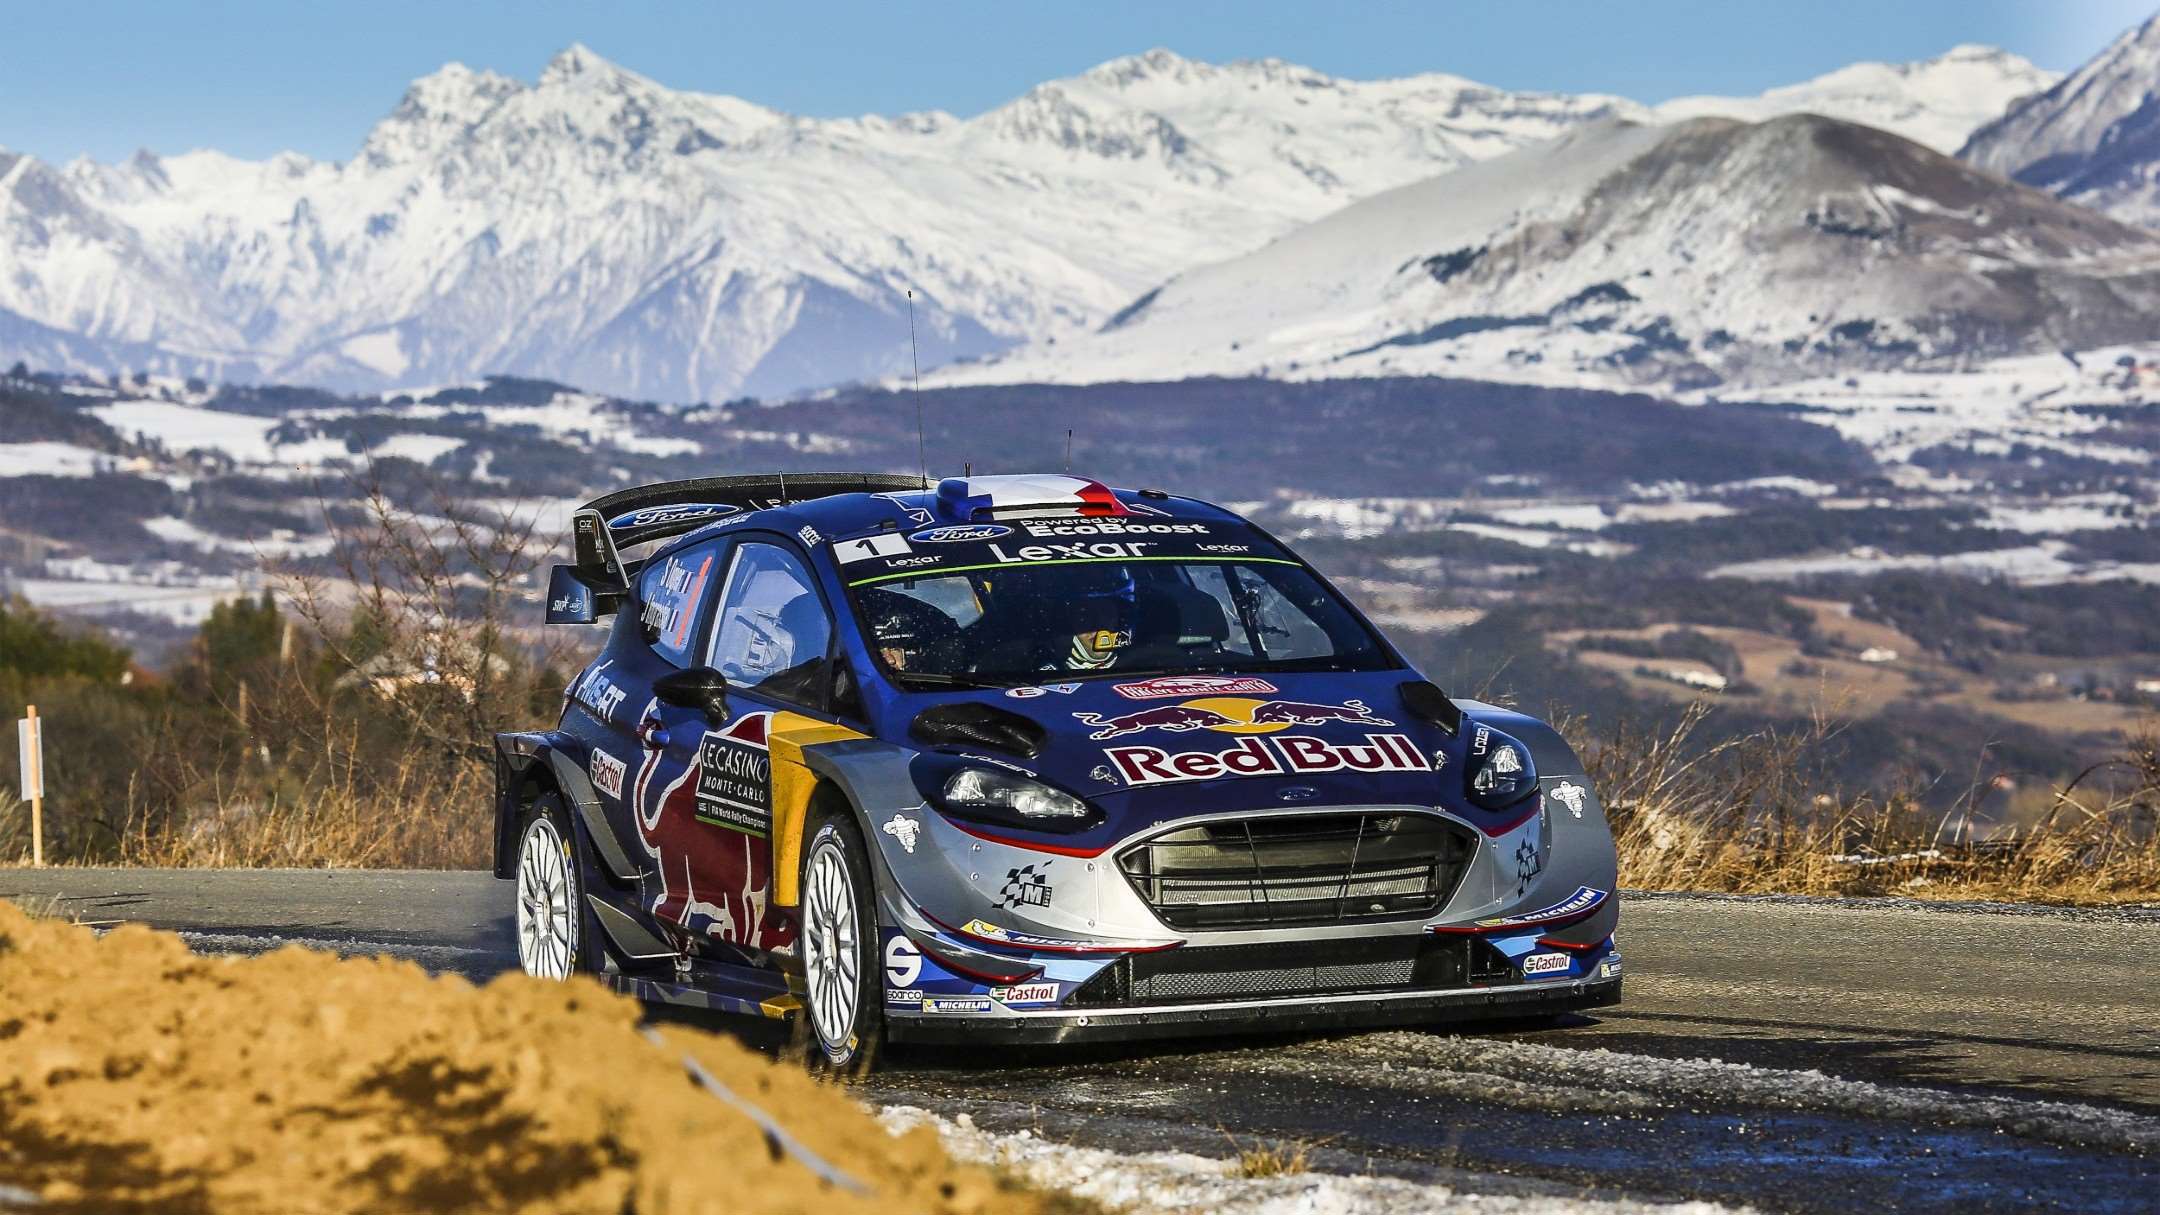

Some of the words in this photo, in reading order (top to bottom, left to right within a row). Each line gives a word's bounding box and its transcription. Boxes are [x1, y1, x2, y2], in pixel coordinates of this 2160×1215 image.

[633, 506, 718, 526] Ford
[1020, 517, 1097, 527] Powered
[1101, 517, 1127, 525] by
[929, 527, 994, 541] Ford
[1027, 523, 1210, 537] EcoBoost
[856, 539, 881, 556] 1
[1196, 543, 1249, 552] Lexar
[886, 555, 942, 567] Lexar
[1108, 736, 1281, 783] Red
[1273, 735, 1428, 771] Bull
[596, 759, 623, 794] Castrol
[1023, 884, 1043, 905] M
[1524, 889, 1597, 922] MICHELIN
[1535, 957, 1569, 971] Castrol
[888, 991, 922, 1000] sparco
[1006, 986, 1055, 1001] Castrol
[938, 1001, 990, 1009] MICHELIN
